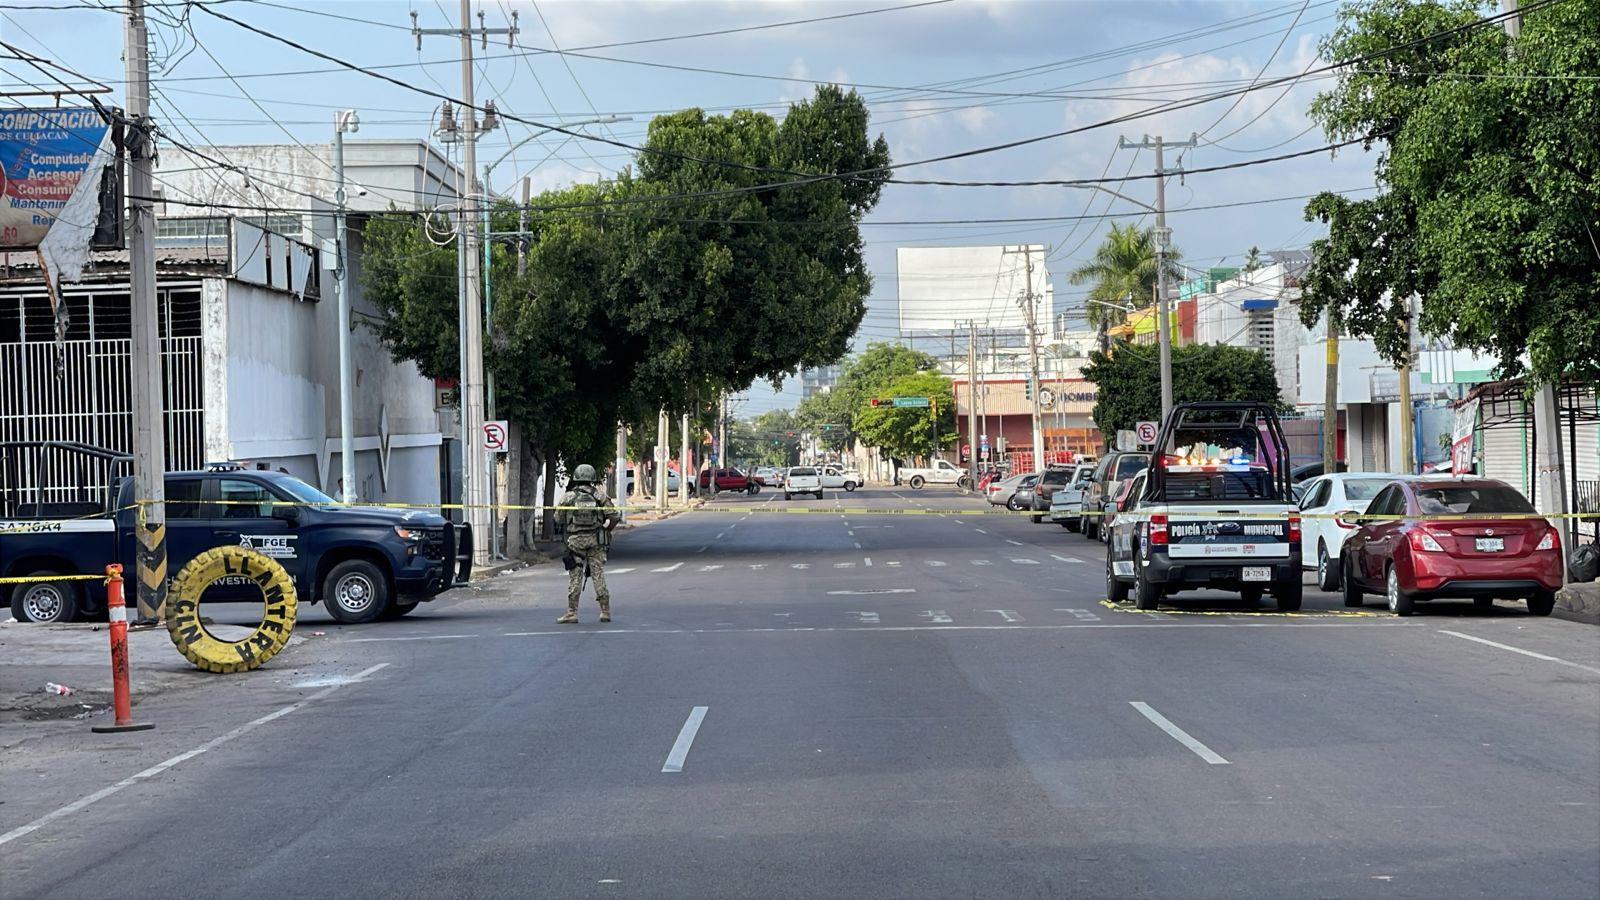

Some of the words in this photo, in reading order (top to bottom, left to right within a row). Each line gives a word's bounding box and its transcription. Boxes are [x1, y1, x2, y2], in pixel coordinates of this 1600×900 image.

[18, 183, 75, 195] Consumi
[1171, 523, 1201, 537] POLICÍA
[1244, 524, 1284, 536] MUNICIPAL
[264, 538, 286, 547] FGE
[223, 555, 286, 662] LLANTERA
